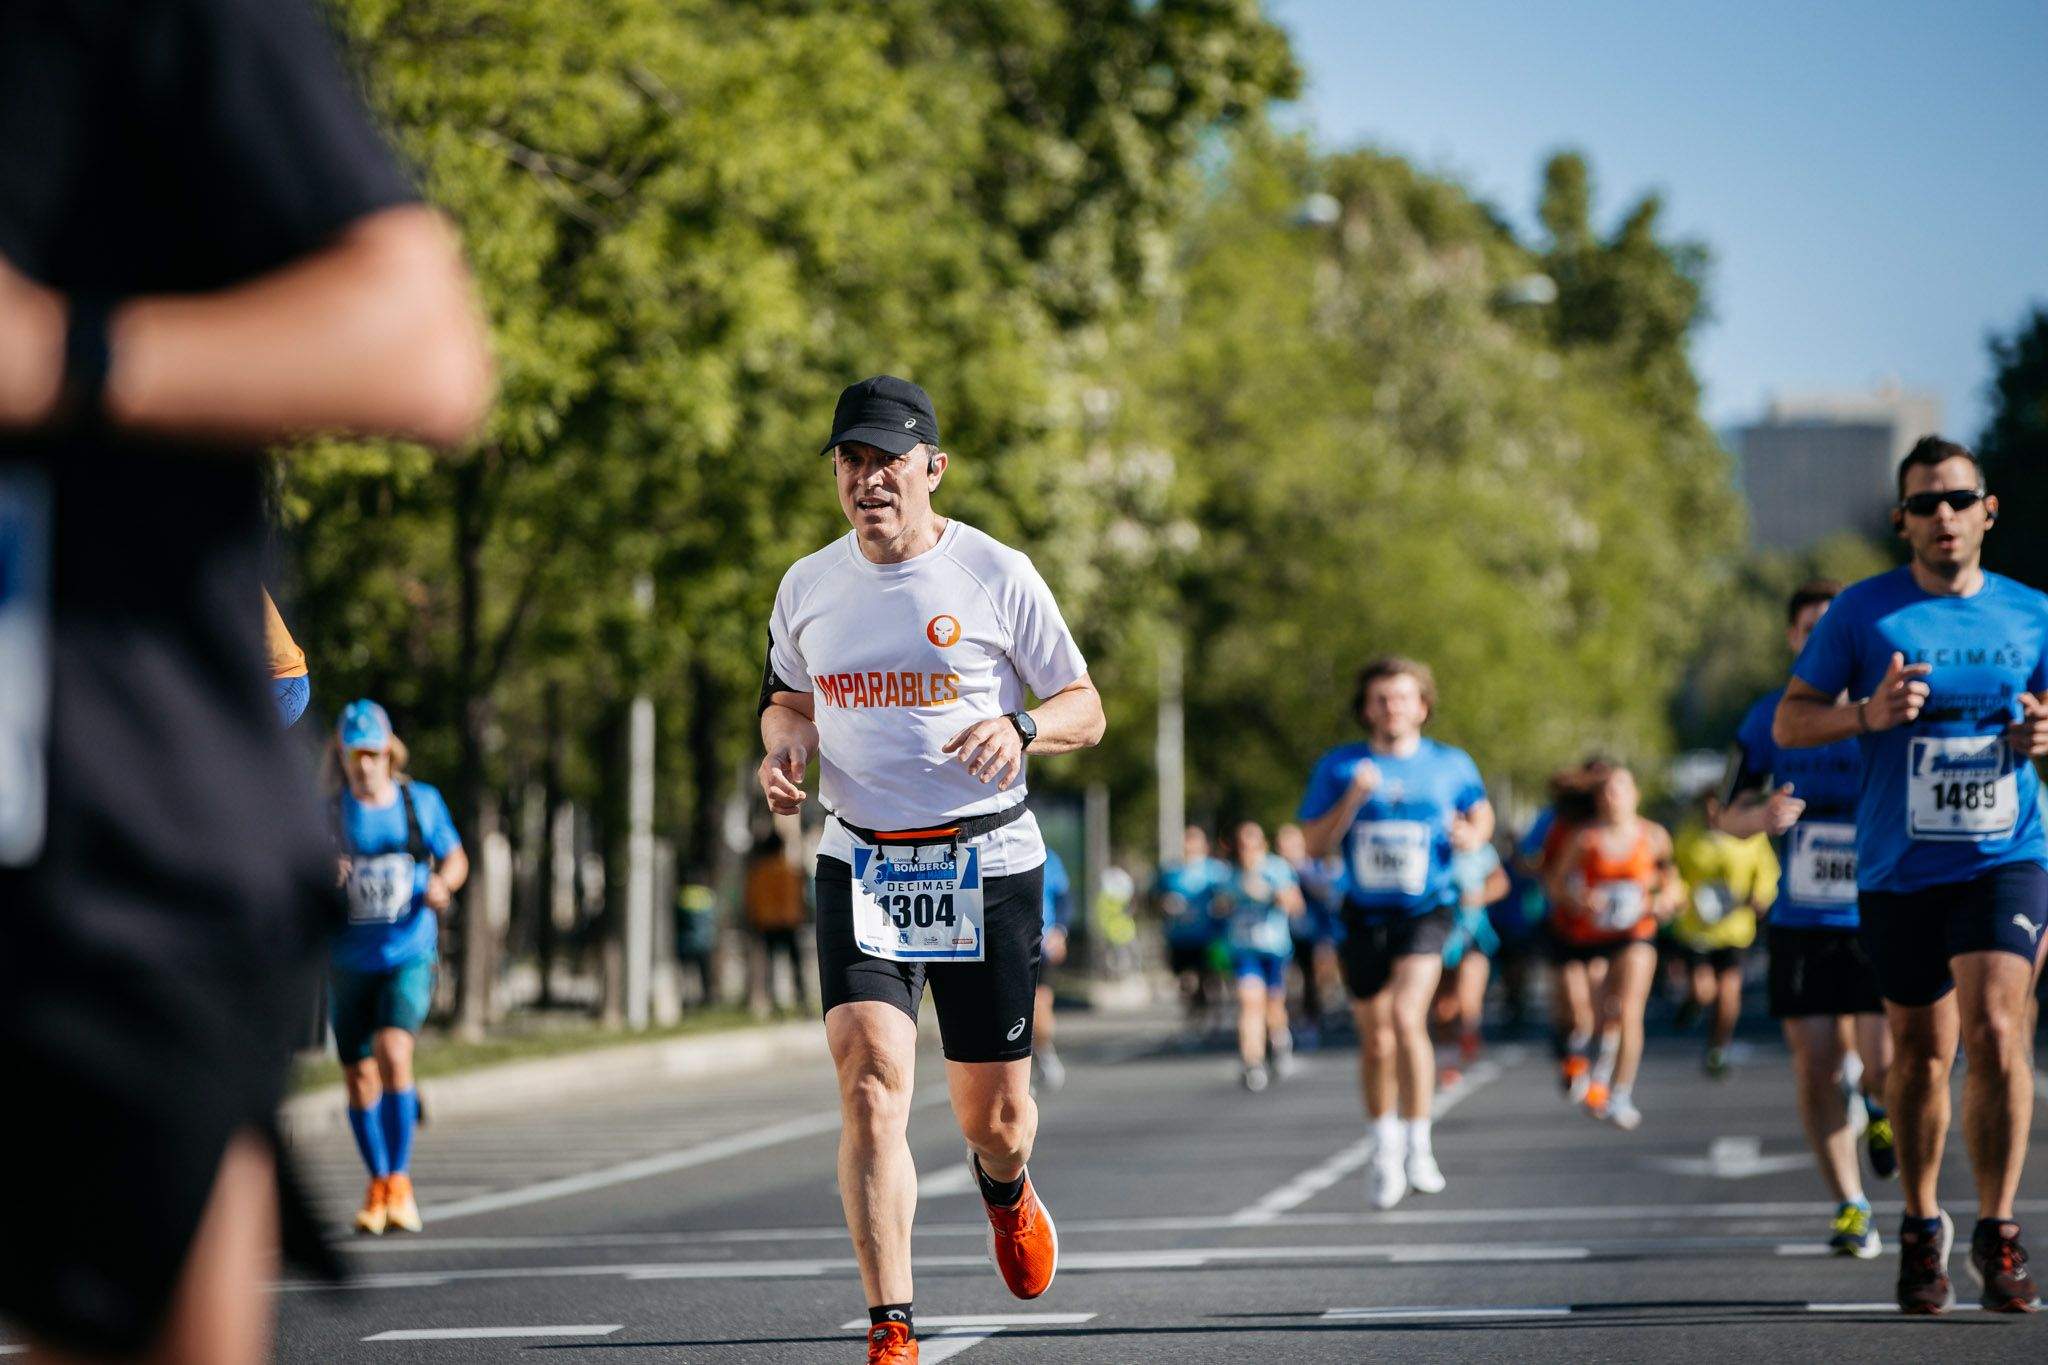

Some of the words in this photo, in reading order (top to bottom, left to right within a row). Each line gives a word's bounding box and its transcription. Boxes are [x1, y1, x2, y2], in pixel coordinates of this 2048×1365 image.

[813, 671, 961, 708] IMPARABLES
[1932, 781, 1996, 811] 1489
[894, 861, 955, 872] BOMBEROS
[887, 881, 954, 891] DECIMAS
[876, 893, 956, 929] 1304
